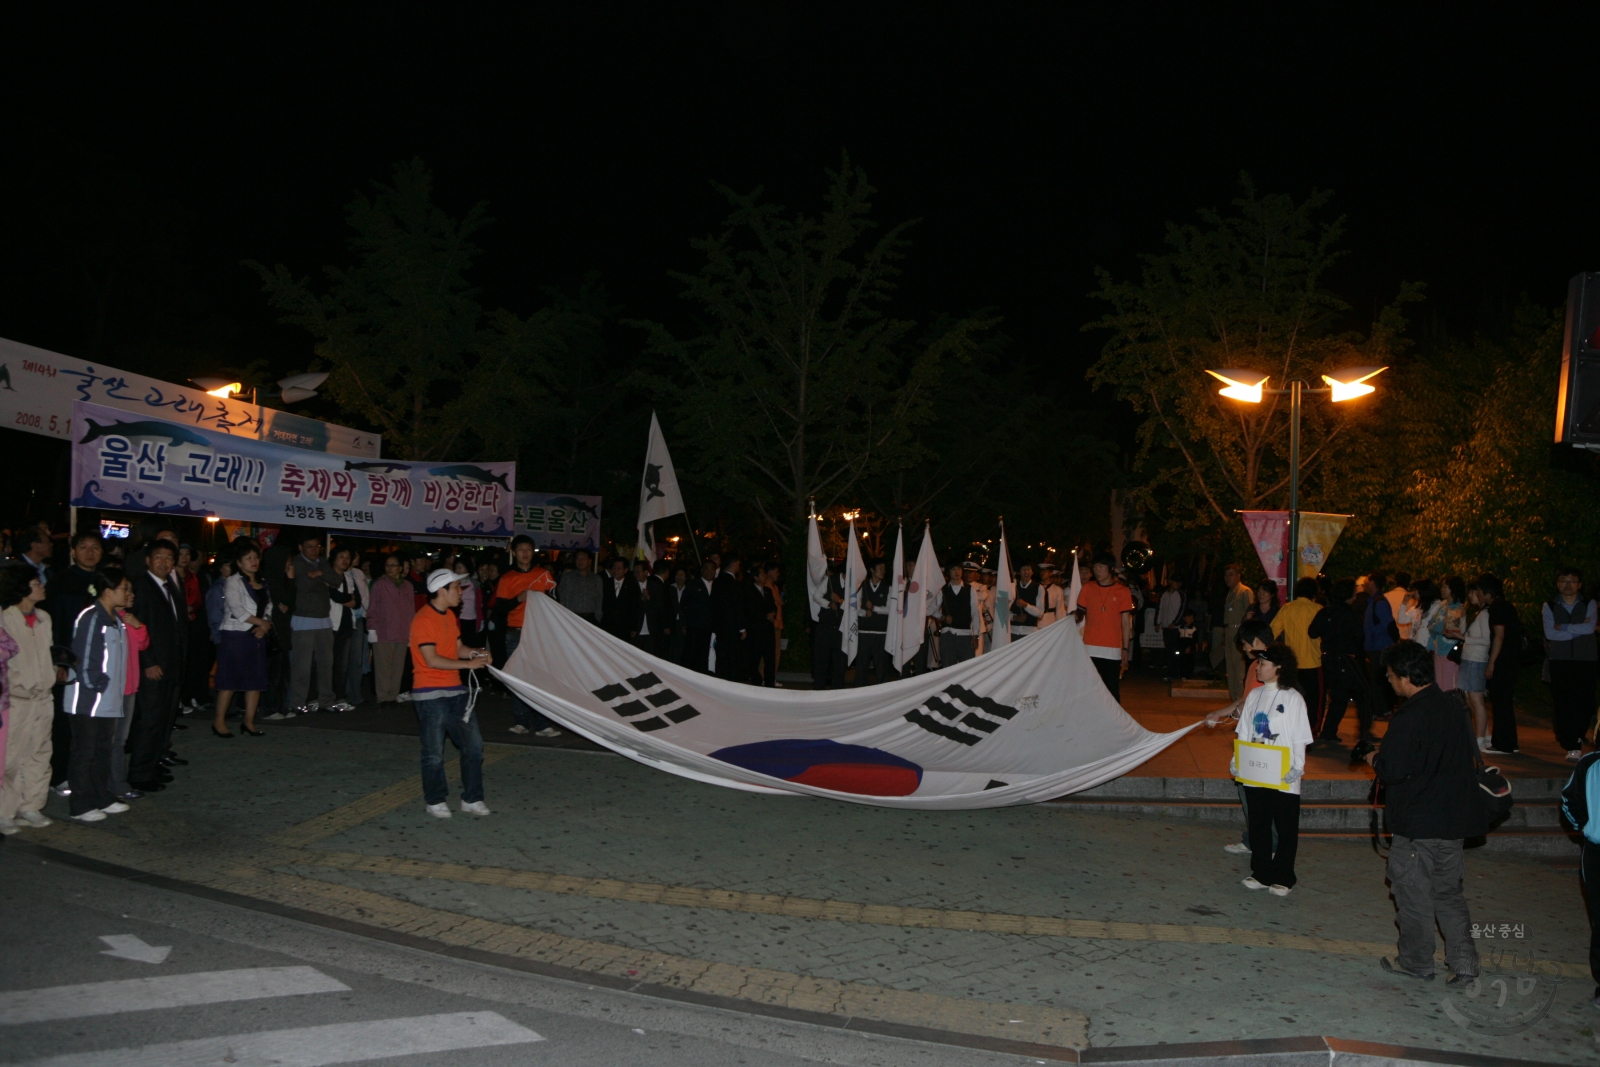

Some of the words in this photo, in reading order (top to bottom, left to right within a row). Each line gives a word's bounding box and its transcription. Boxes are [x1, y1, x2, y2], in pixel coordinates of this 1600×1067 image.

[22, 360, 57, 378] 제14회
[15, 411, 43, 430] 2008.
[101, 438, 166, 481] 울산
[184, 452, 265, 493] 고래!!
[280, 463, 357, 502] 축제와
[367, 474, 412, 507] 함께
[423, 480, 500, 514] 비상한다
[285, 504, 326, 521] 신정2동
[331, 508, 375, 524] 주민센터
